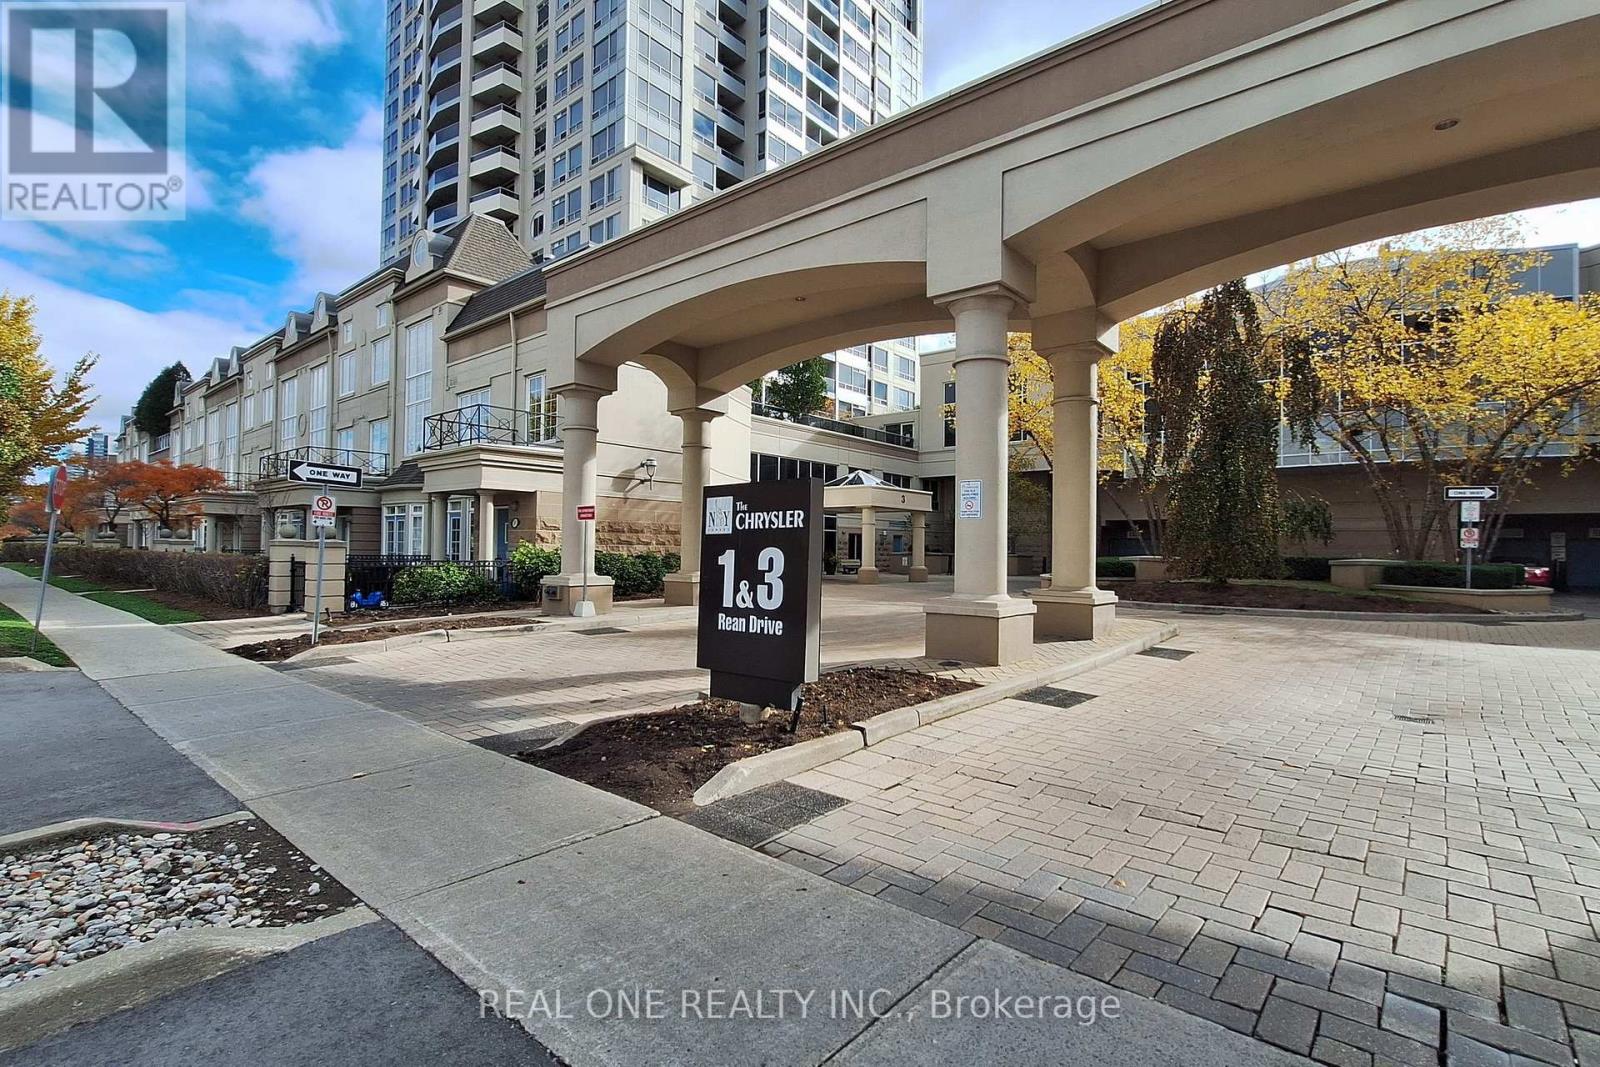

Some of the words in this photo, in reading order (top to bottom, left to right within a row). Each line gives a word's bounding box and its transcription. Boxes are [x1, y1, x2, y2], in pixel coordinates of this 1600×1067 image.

[309, 469, 328, 477] ONE
[332, 472, 351, 480] WAY
[901, 495, 906, 503] 3
[736, 510, 804, 529] CHRYSLER
[718, 613, 746, 632] Rean
[750, 615, 783, 635] Drive
